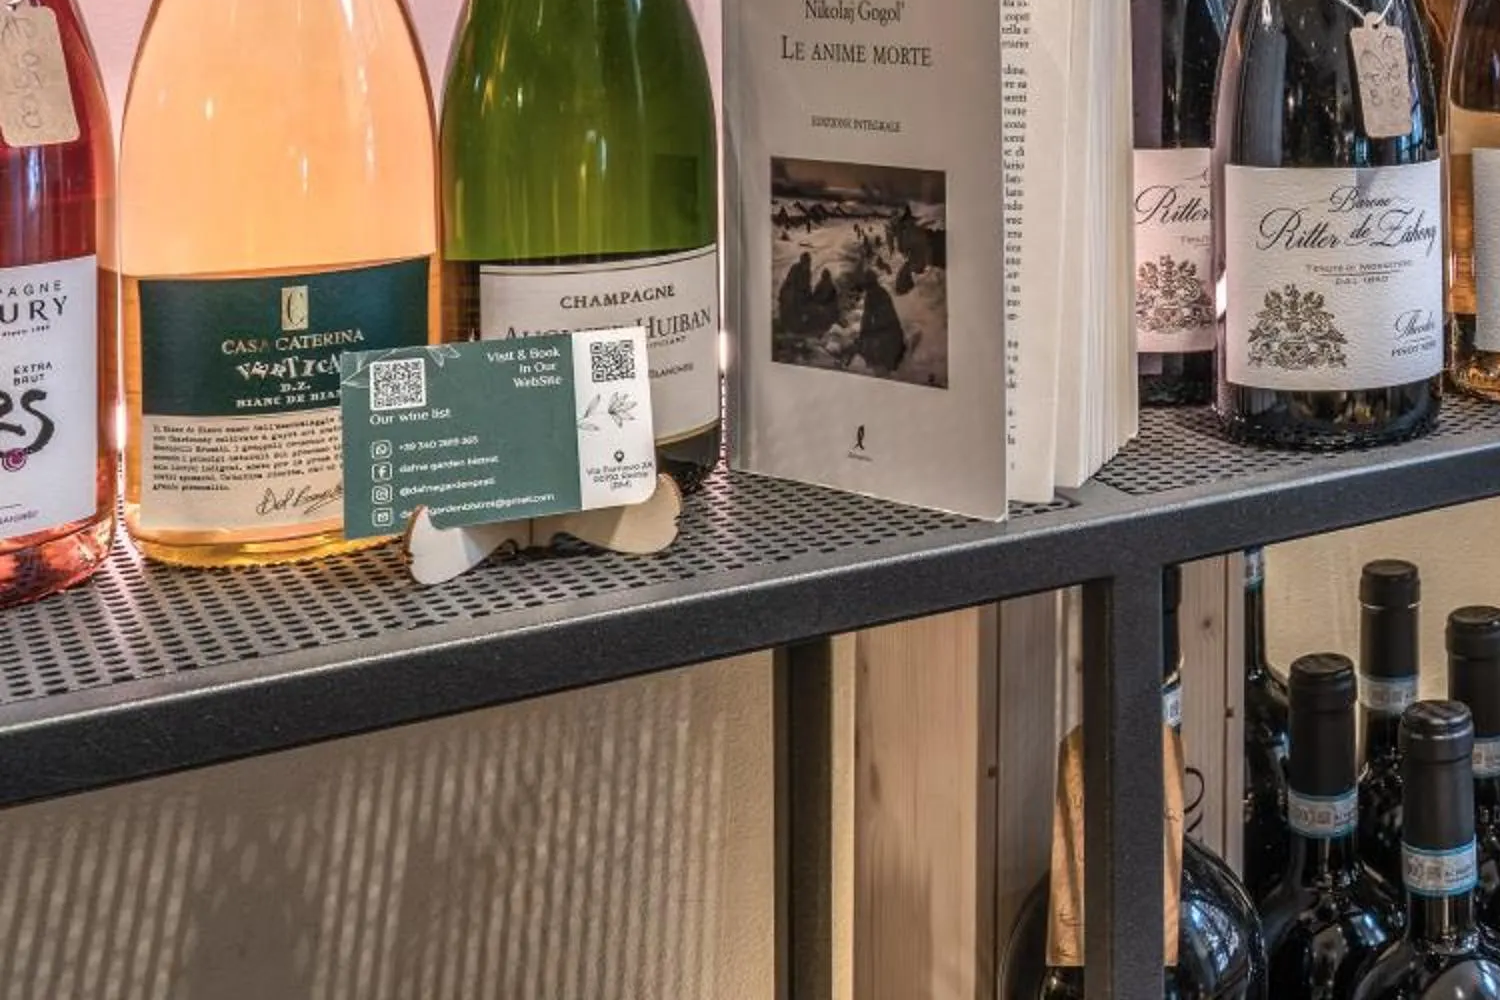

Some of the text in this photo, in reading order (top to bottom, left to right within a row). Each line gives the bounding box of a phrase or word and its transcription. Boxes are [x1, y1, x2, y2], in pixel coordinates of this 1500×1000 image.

[804, 0, 855, 25] Nikolaj
[811, 42, 867, 63] ANIME
[873, 44, 931, 67] MORTE
[1328, 185, 1391, 212] Barone
[1256, 207, 1340, 250] Ritter
[560, 283, 675, 310] CHAMPAGNE
[221, 327, 365, 355] CASA CATERINA
[486, 346, 561, 362] Visit & Book
[534, 361, 557, 372] Our
[13, 361, 53, 375] EXTRA
[13, 373, 45, 386] BRUT
[369, 408, 451, 426] Our wine list
